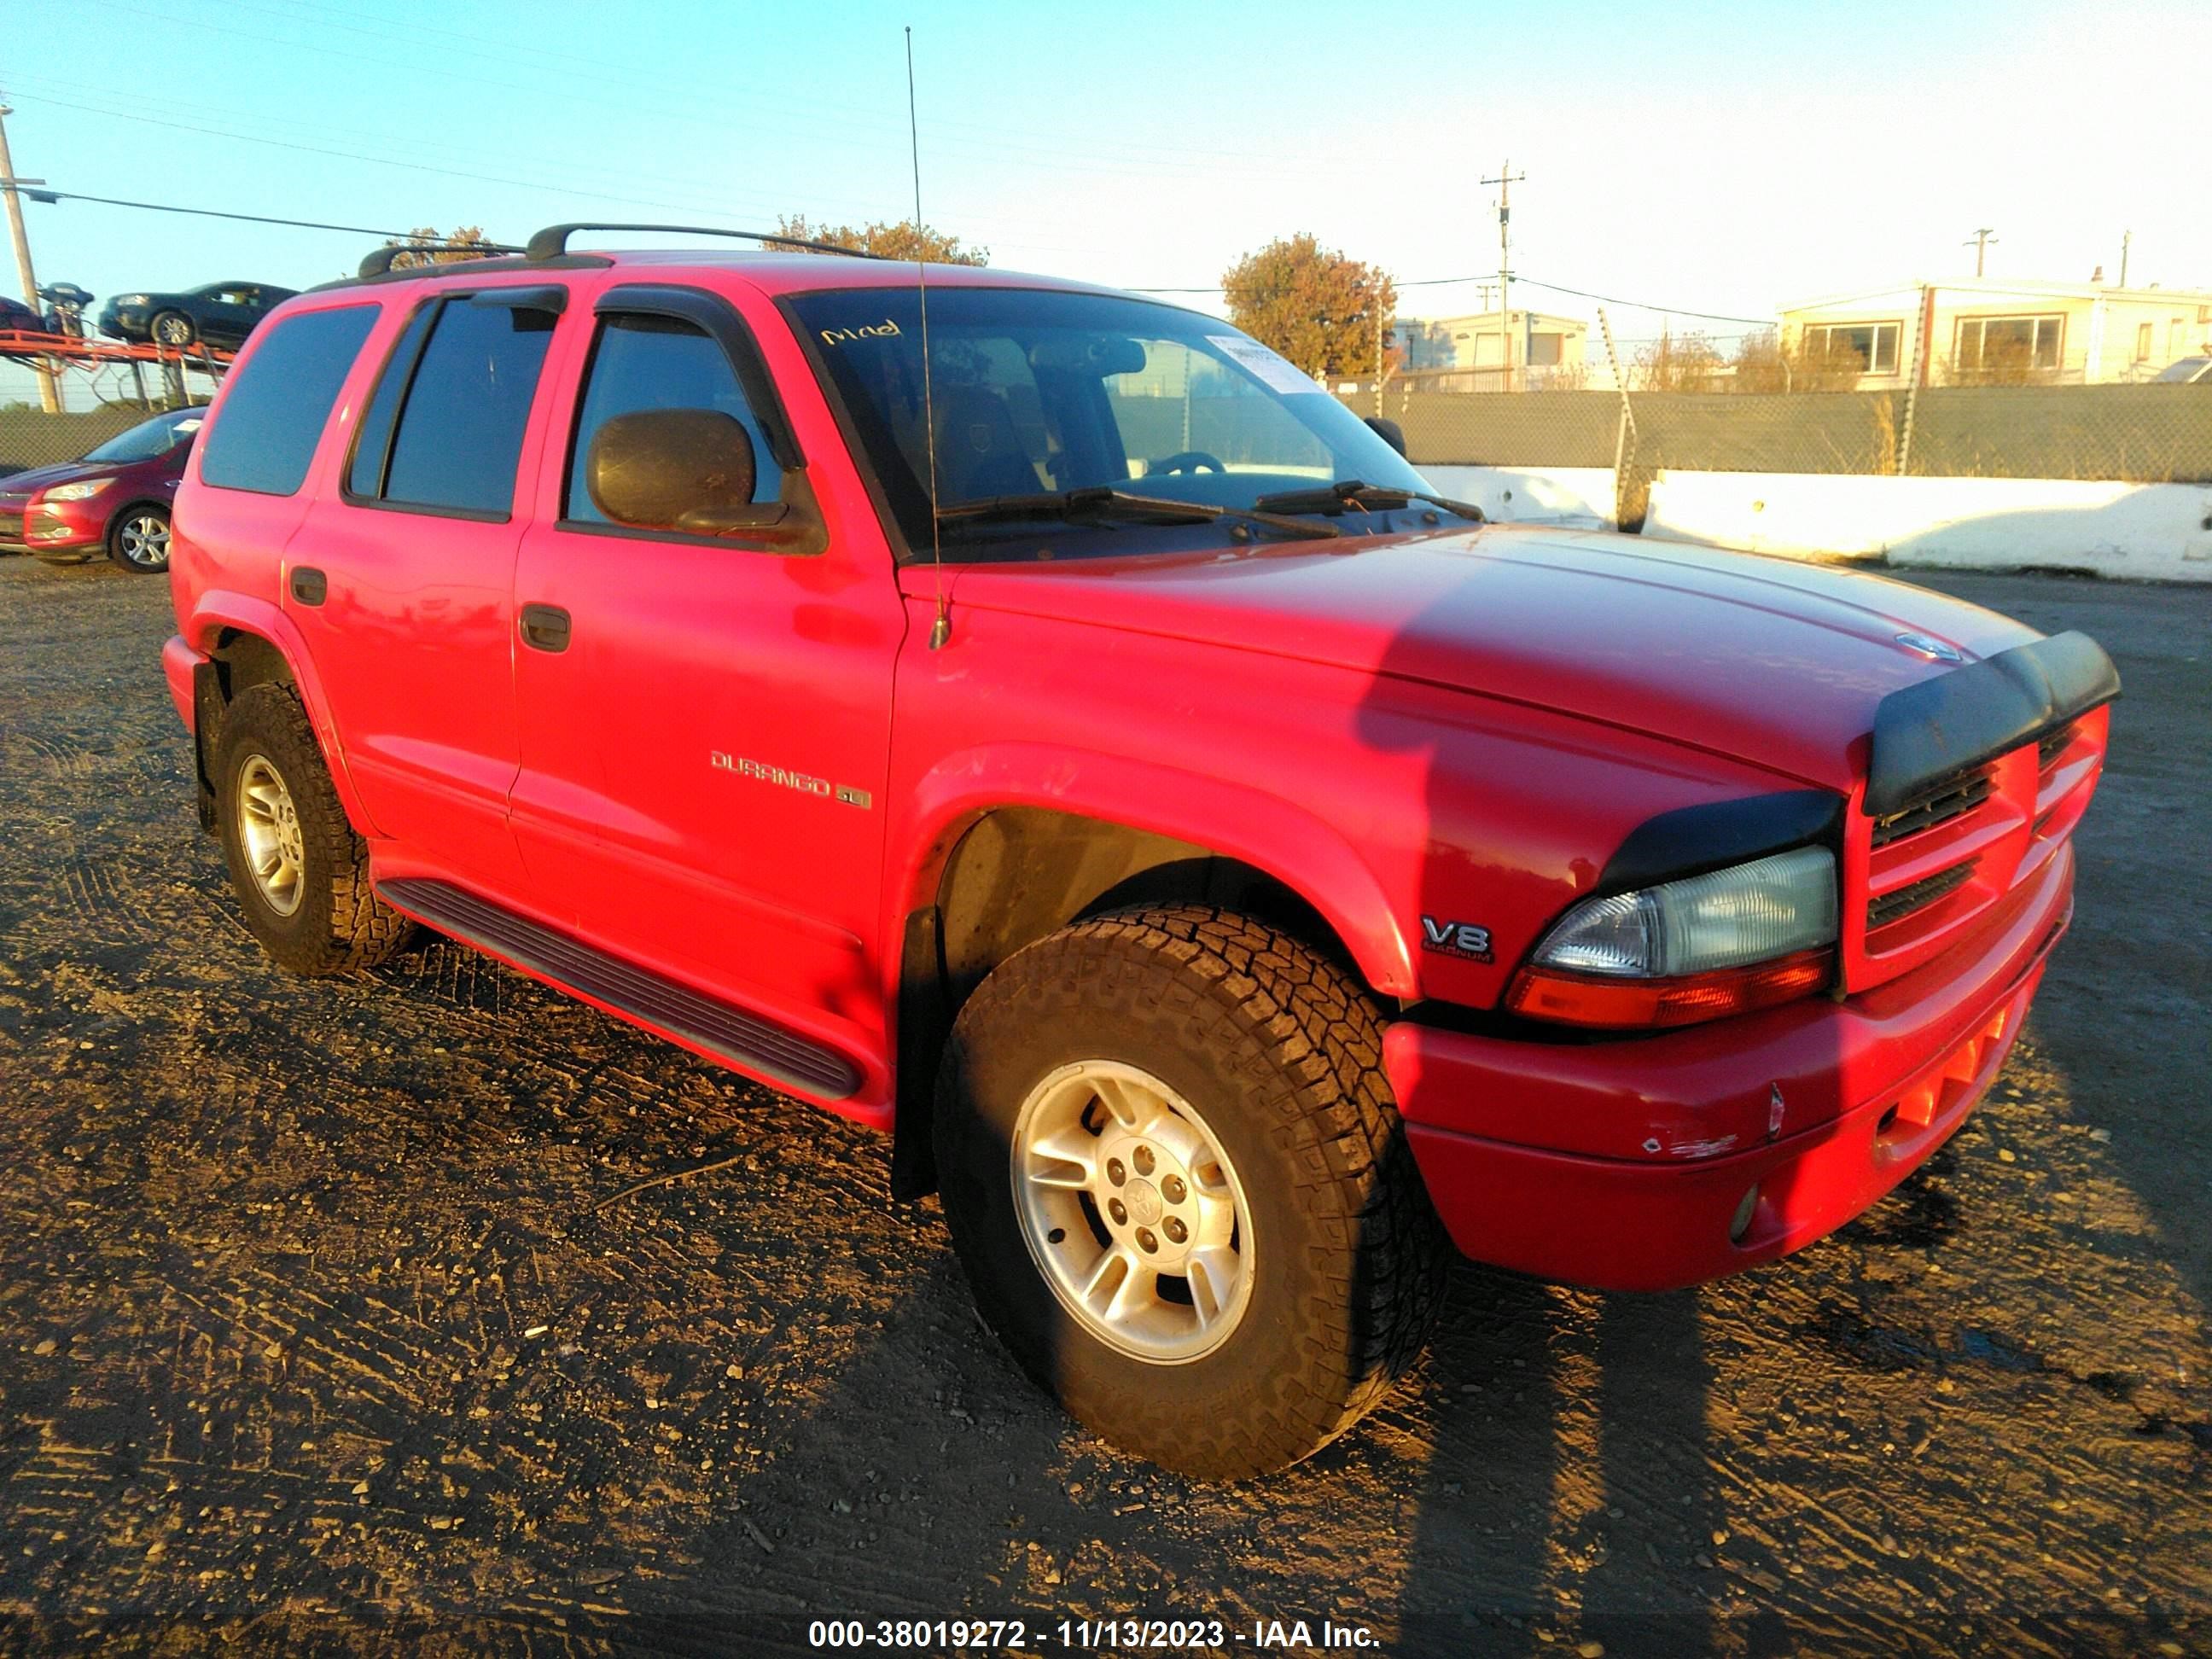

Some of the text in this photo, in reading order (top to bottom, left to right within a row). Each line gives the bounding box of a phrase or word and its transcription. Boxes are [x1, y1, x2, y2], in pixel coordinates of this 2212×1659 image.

[711, 751, 830, 796] DURANGO
[1422, 941, 1492, 963] MAGNUM
[1423, 917, 1488, 952] V8
